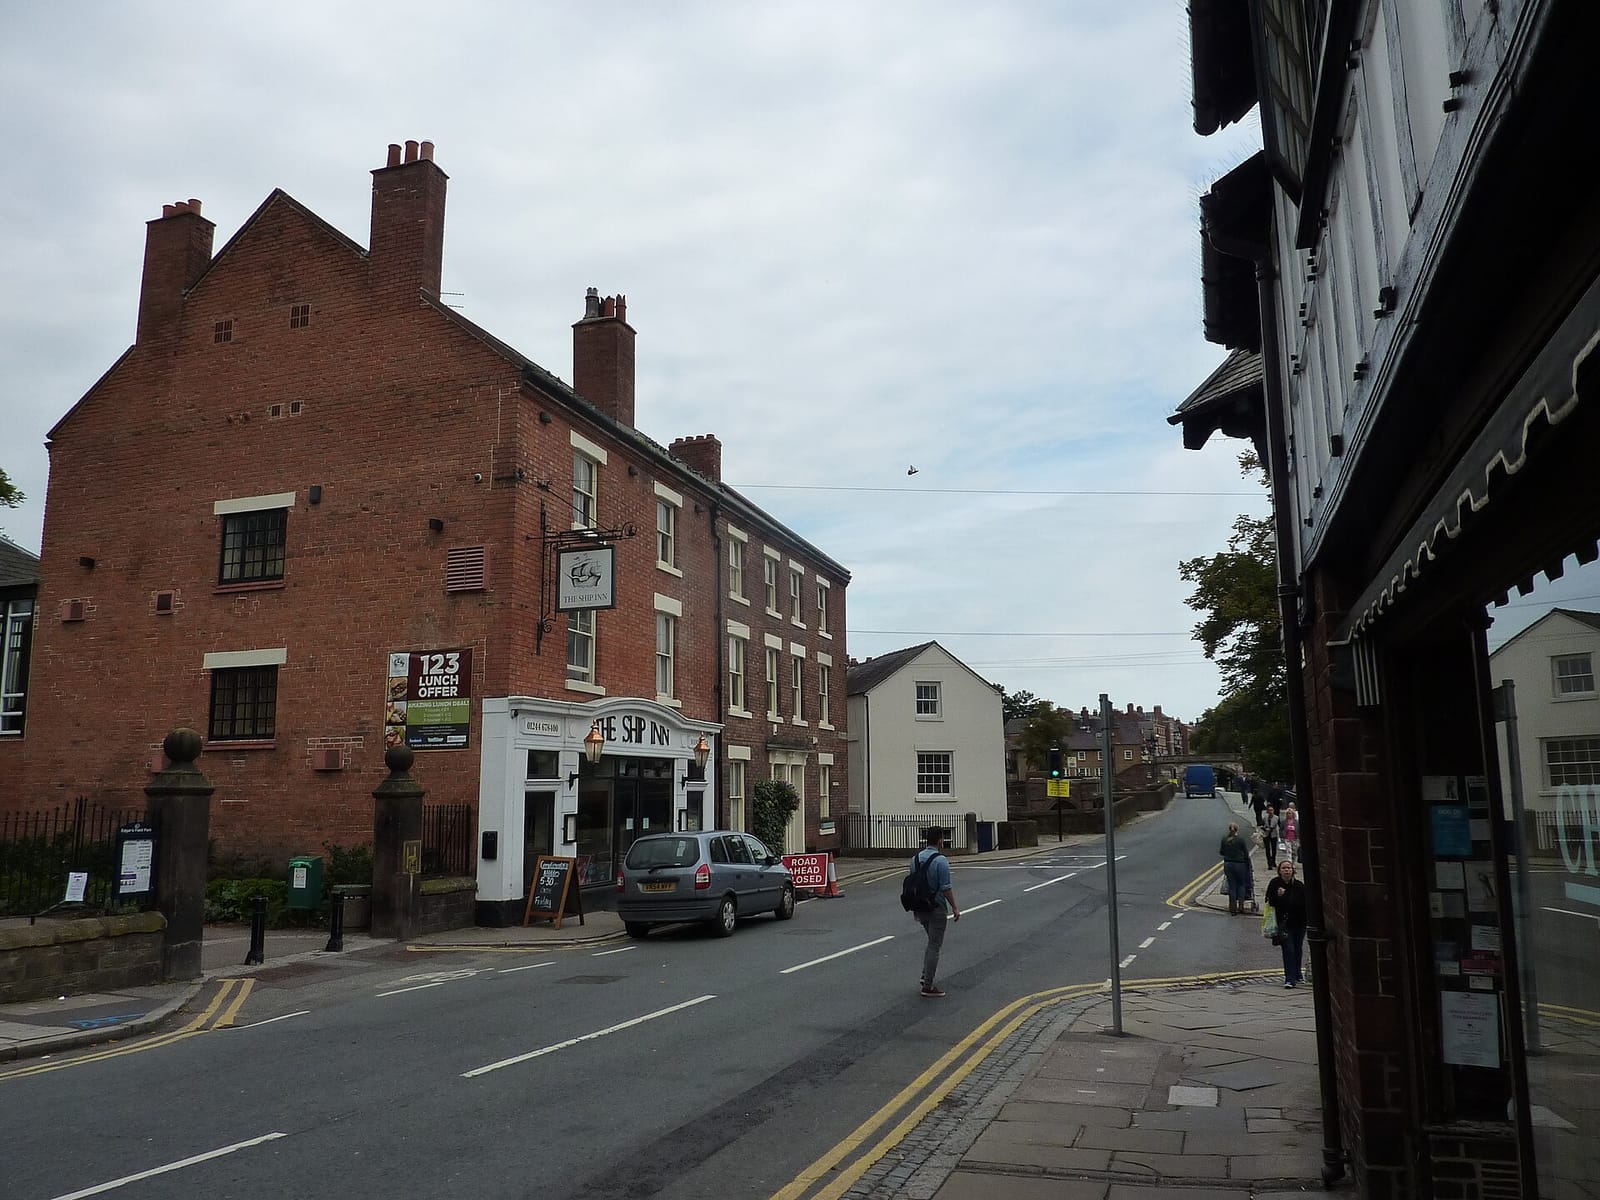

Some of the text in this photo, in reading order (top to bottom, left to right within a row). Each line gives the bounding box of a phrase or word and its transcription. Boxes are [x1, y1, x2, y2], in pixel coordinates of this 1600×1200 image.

[564, 594, 577, 603] THE
[594, 592, 608, 601] INN
[420, 653, 460, 675] 123
[418, 674, 459, 686] LUNCH
[418, 686, 458, 698] OFFER
[650, 720, 670, 746] INN
[791, 857, 818, 867] ROAD
[788, 866, 820, 875] AHEAD
[791, 874, 823, 884] LOSED
